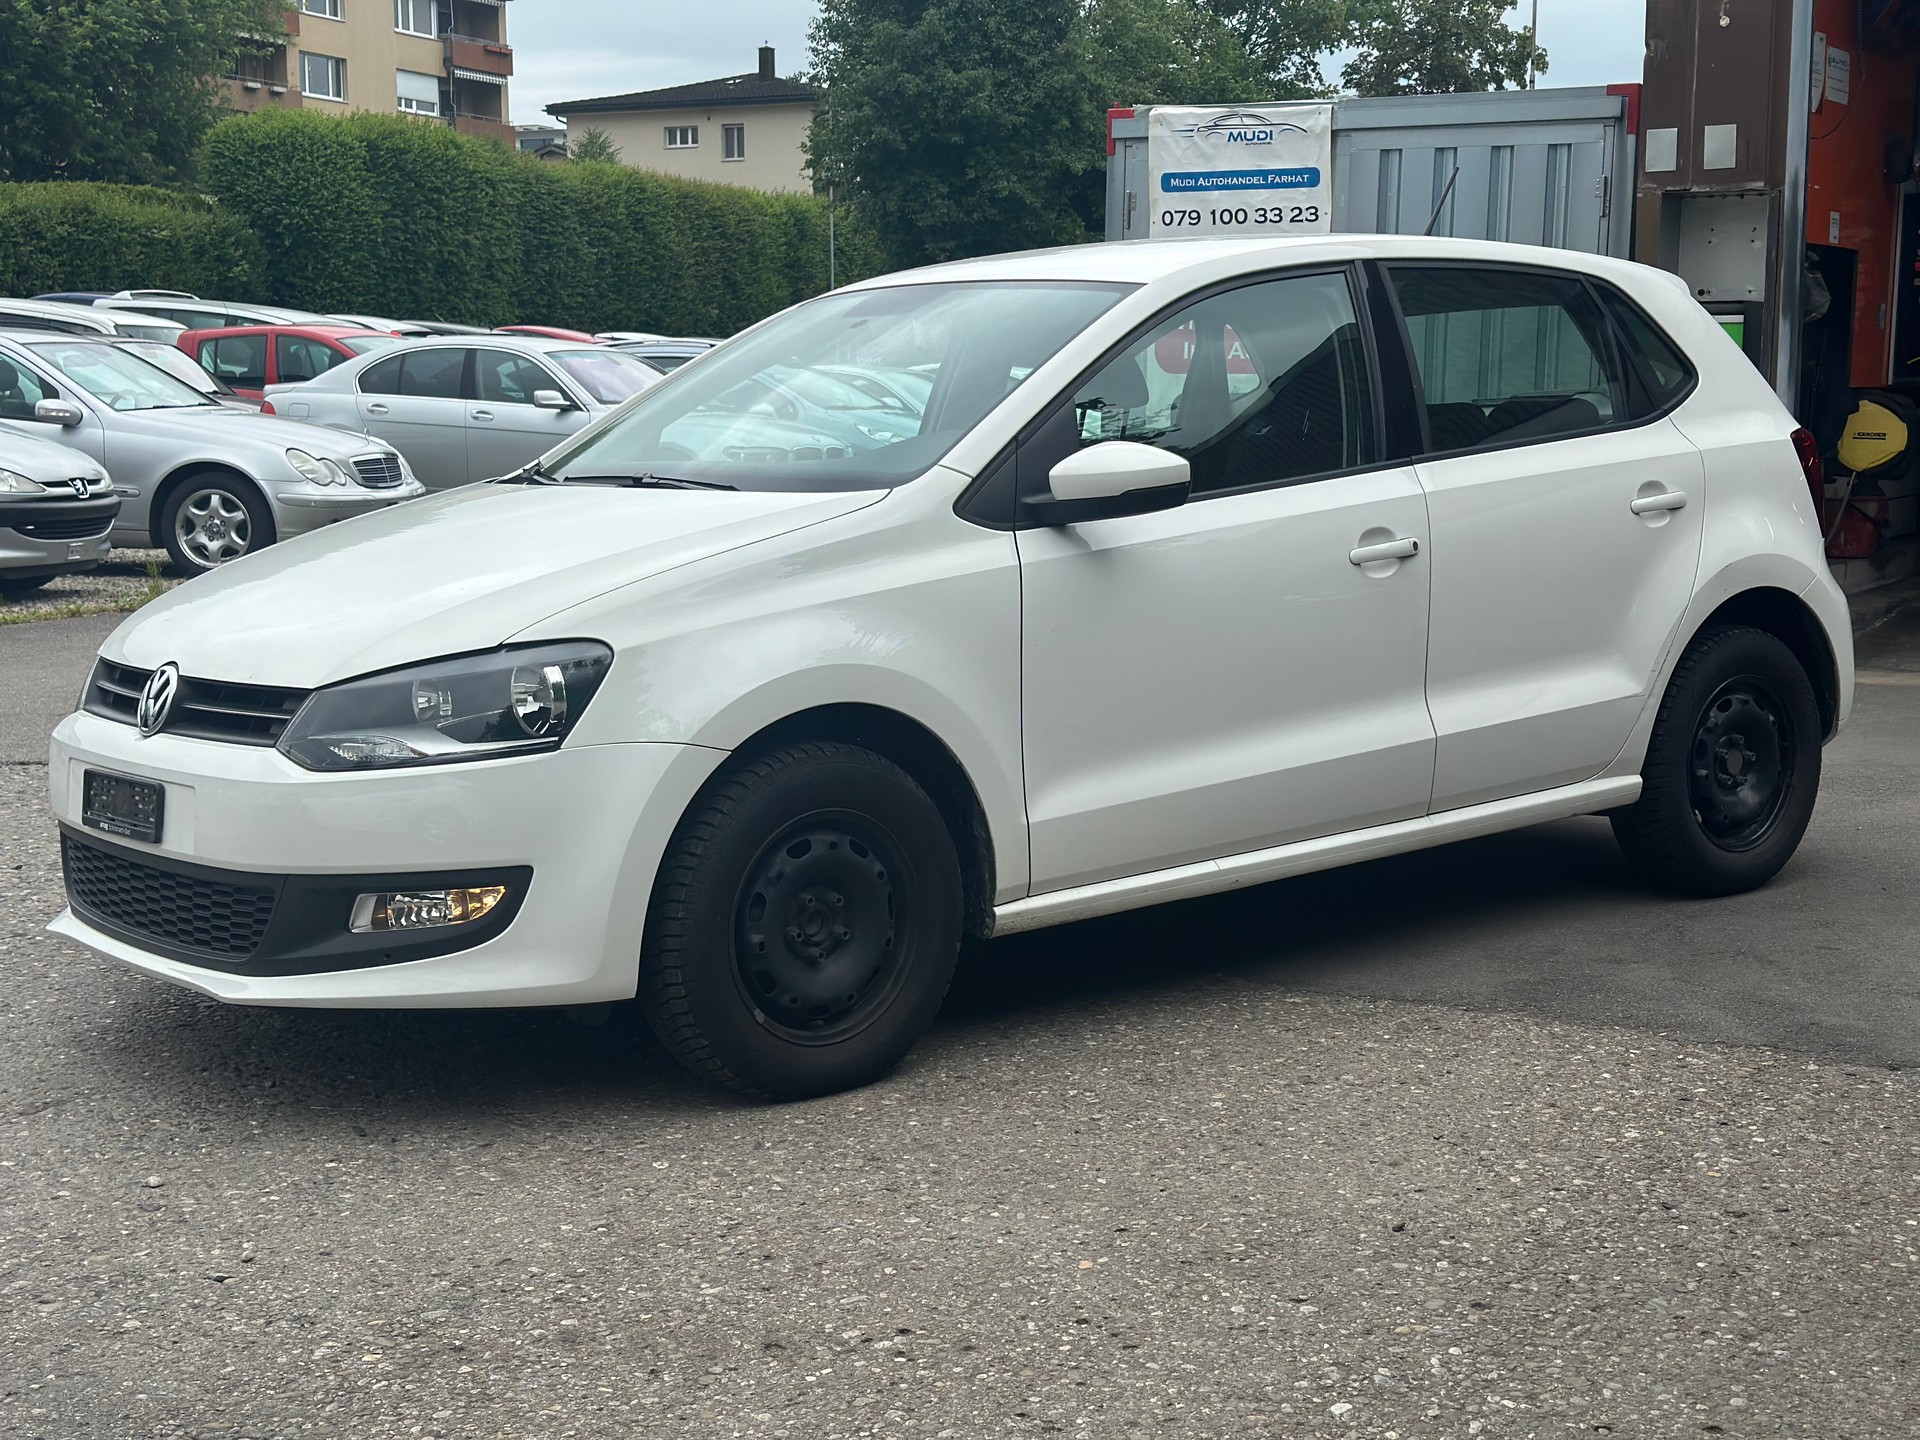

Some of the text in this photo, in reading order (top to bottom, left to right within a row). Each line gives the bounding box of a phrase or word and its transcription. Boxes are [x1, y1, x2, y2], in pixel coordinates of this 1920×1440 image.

[1227, 130, 1273, 142] MUDI
[1197, 176, 1266, 186] AUTOHANDEL
[1267, 174, 1309, 184] FARHAT
[1161, 205, 1319, 227] 079 100 33 23
